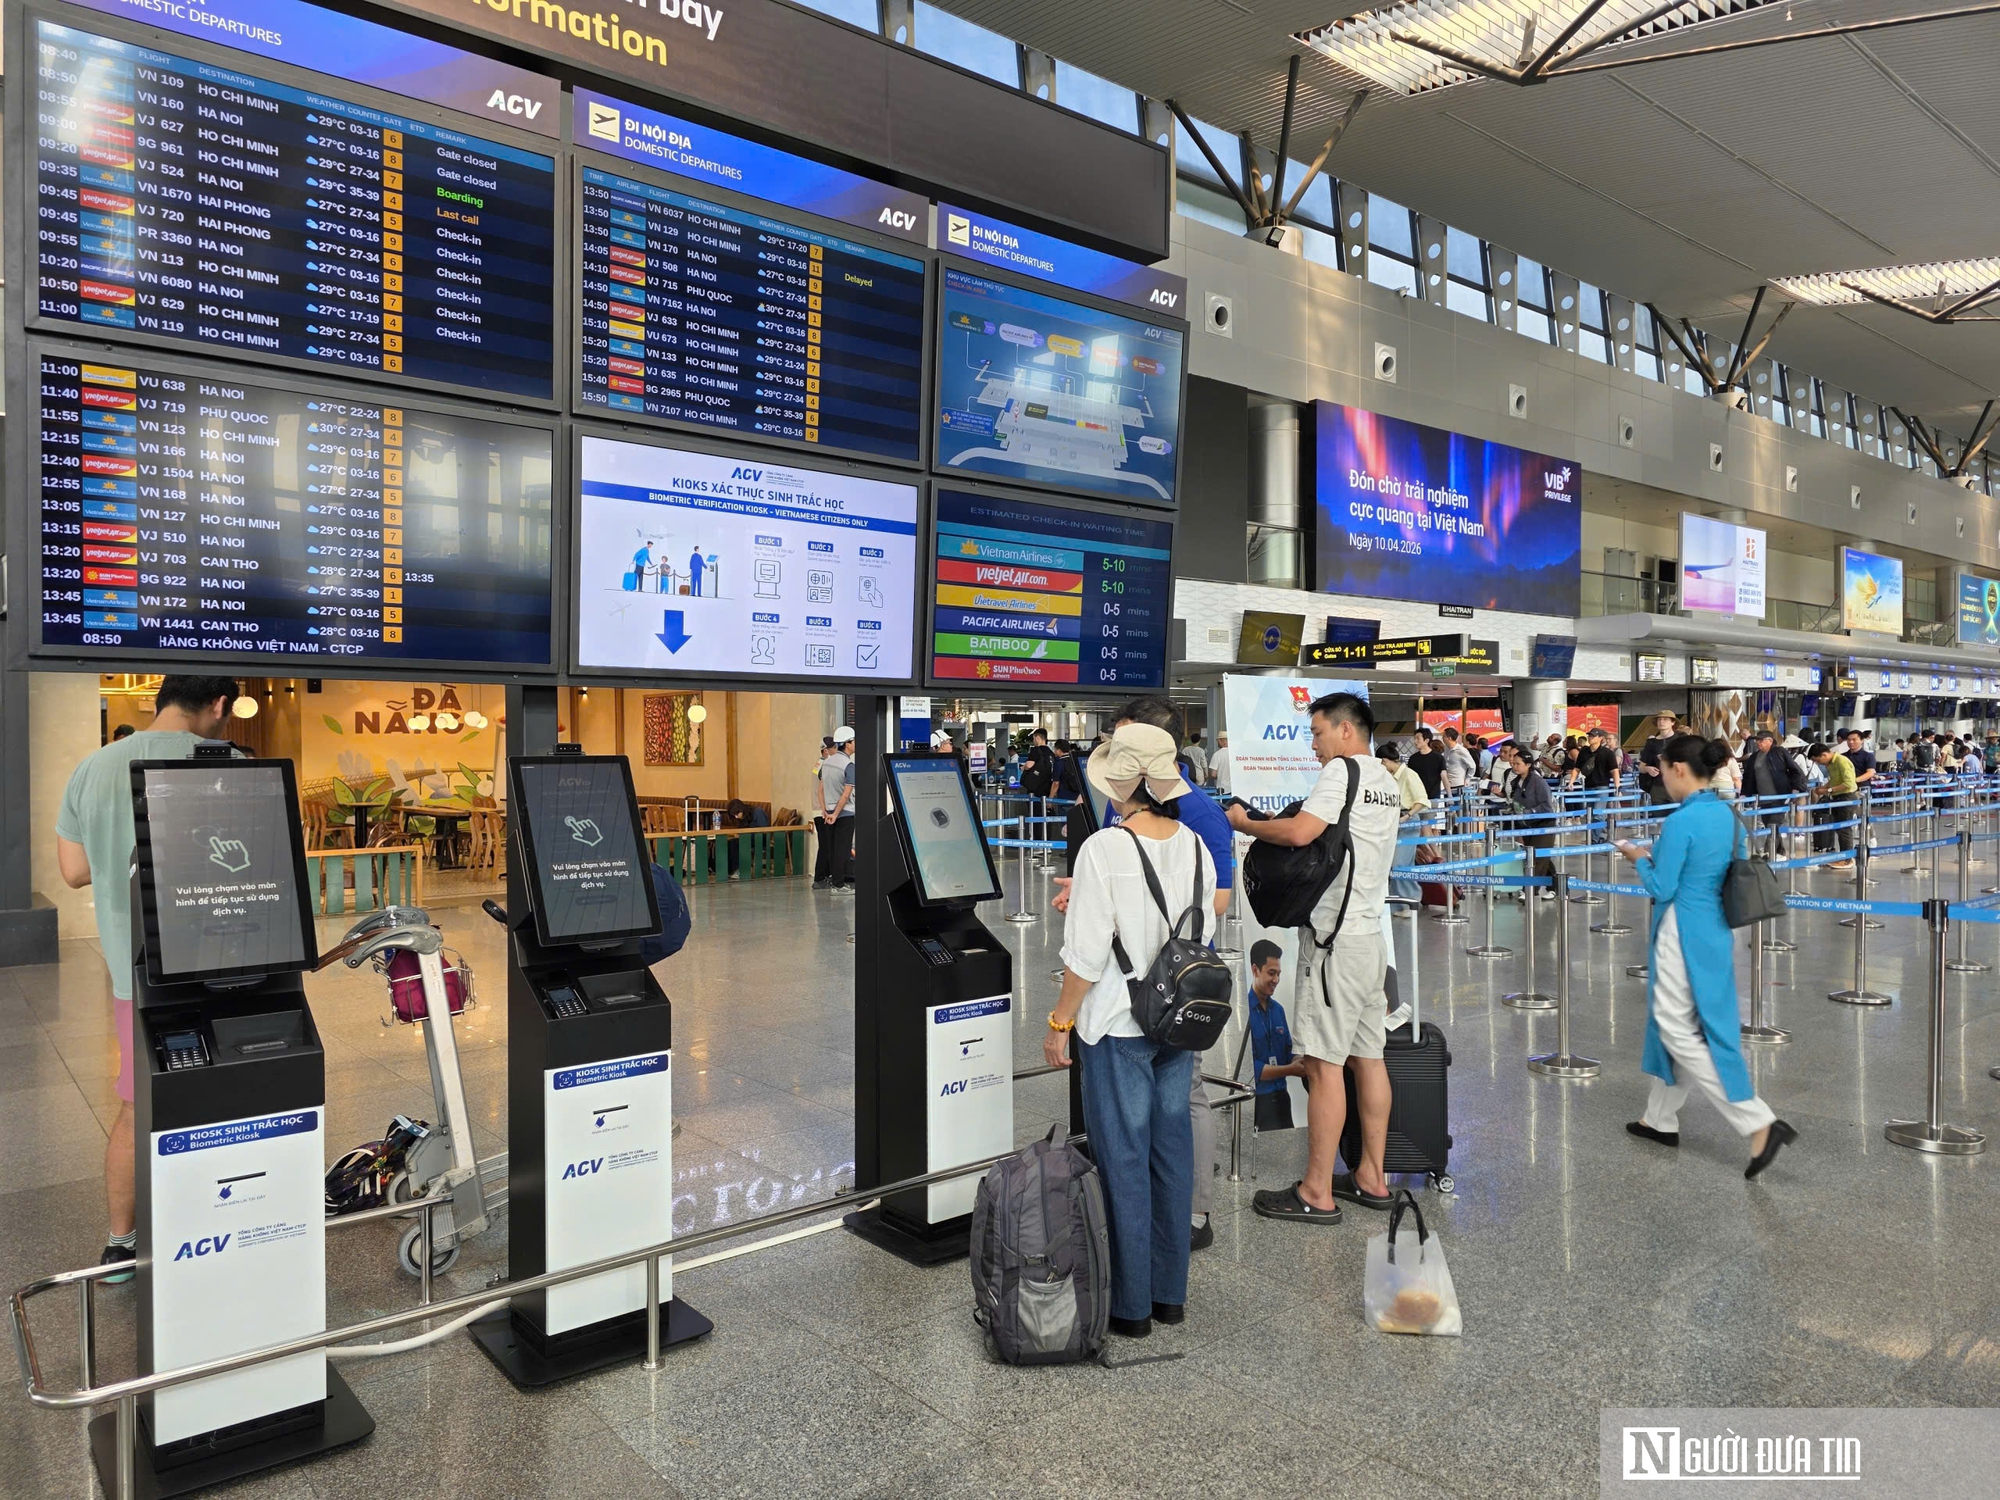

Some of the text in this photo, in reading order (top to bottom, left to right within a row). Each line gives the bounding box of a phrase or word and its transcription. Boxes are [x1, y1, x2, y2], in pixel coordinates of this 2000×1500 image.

[189, 9, 282, 46] DEPARTURES
[660, 0, 723, 41] bay
[486, 89, 542, 120] ACV
[39, 67, 497, 191] 08:50 VN 160 HA NOI 27°C 03-16 8 Gate closed
[625, 118, 692, 151] ĐI NỘI ĐỊA
[625, 136, 742, 181] DOMESTIC DEPARTURES
[437, 186, 484, 208] Boarding
[437, 207, 479, 225] Last call
[879, 207, 916, 232] ACV
[437, 227, 482, 246] Check-in
[973, 226, 1019, 250] ĐI NỘI ĐỊA
[973, 241, 1055, 273] DOMESTIC DEPARTURES
[844, 272, 873, 288] Delayed
[1150, 288, 1178, 308] ACV
[731, 466, 763, 482] ACV
[1544, 472, 1564, 491] VIB
[672, 477, 845, 511] KIOKS XÁC THỰC SINH TRẮC HỌC
[1349, 469, 1469, 511] Đón chờ trải nghiệm
[1544, 491, 1572, 503] PRIVILEGE
[649, 492, 869, 527] BIOMETRIC VERIFICATION KIOSK VIETNAMESE CITIZENS ONLY
[970, 506, 1146, 537] ESTIMATED CHECK-IN WAITING TIME
[1350, 501, 1485, 538] cực quang tại Việt Nam
[1349, 532, 1422, 556] Ngày 10.04.2026
[1103, 557, 1126, 573] 5-10
[1102, 580, 1125, 595] 5-10
[974, 594, 1037, 610] Vietravel Airlines
[1103, 602, 1150, 617] 0-5 mins
[962, 615, 1045, 631] PACIFIC AIRLINES
[83, 633, 122, 645] 08:50
[201, 636, 253, 651] KHÔNG
[256, 639, 286, 653] VIỆT
[289, 642, 319, 653] NAM
[329, 644, 364, 655] CTCP
[970, 637, 1030, 651] BAMBOO
[1343, 645, 1366, 659] 1-11
[1373, 648, 1407, 657] Security Check
[993, 665, 1042, 676] SUN PhuQuoc
[1766, 666, 1774, 678] 01
[1812, 669, 1820, 681] 02
[1882, 673, 1889, 685] 04
[411, 684, 462, 710] ĐÀ
[1262, 725, 1299, 740] ACV
[1390, 871, 1419, 880] AIRPORTS
[1419, 873, 1465, 883] CORPORATION
[176, 887, 191, 895] Vui
[194, 886, 213, 896] lòng
[215, 884, 238, 894] chạm
[1616, 886, 1632, 894] NAM
[176, 898, 196, 907] hình
[198, 896, 209, 905] để
[211, 895, 228, 905] tiếp
[230, 895, 244, 904] tục
[258, 893, 280, 902] dụng
[1822, 900, 1833, 909] OF
[1835, 901, 1872, 911] VIETNAM
[212, 908, 247, 917] dịch vụ.
[940, 1080, 968, 1097] ACV
[190, 1115, 304, 1141] KIOSK SINH TRẮC HỌC
[190, 1132, 260, 1149] Biometric Kiosk
[562, 1157, 604, 1180] ACV
[174, 1234, 231, 1262] ACV
